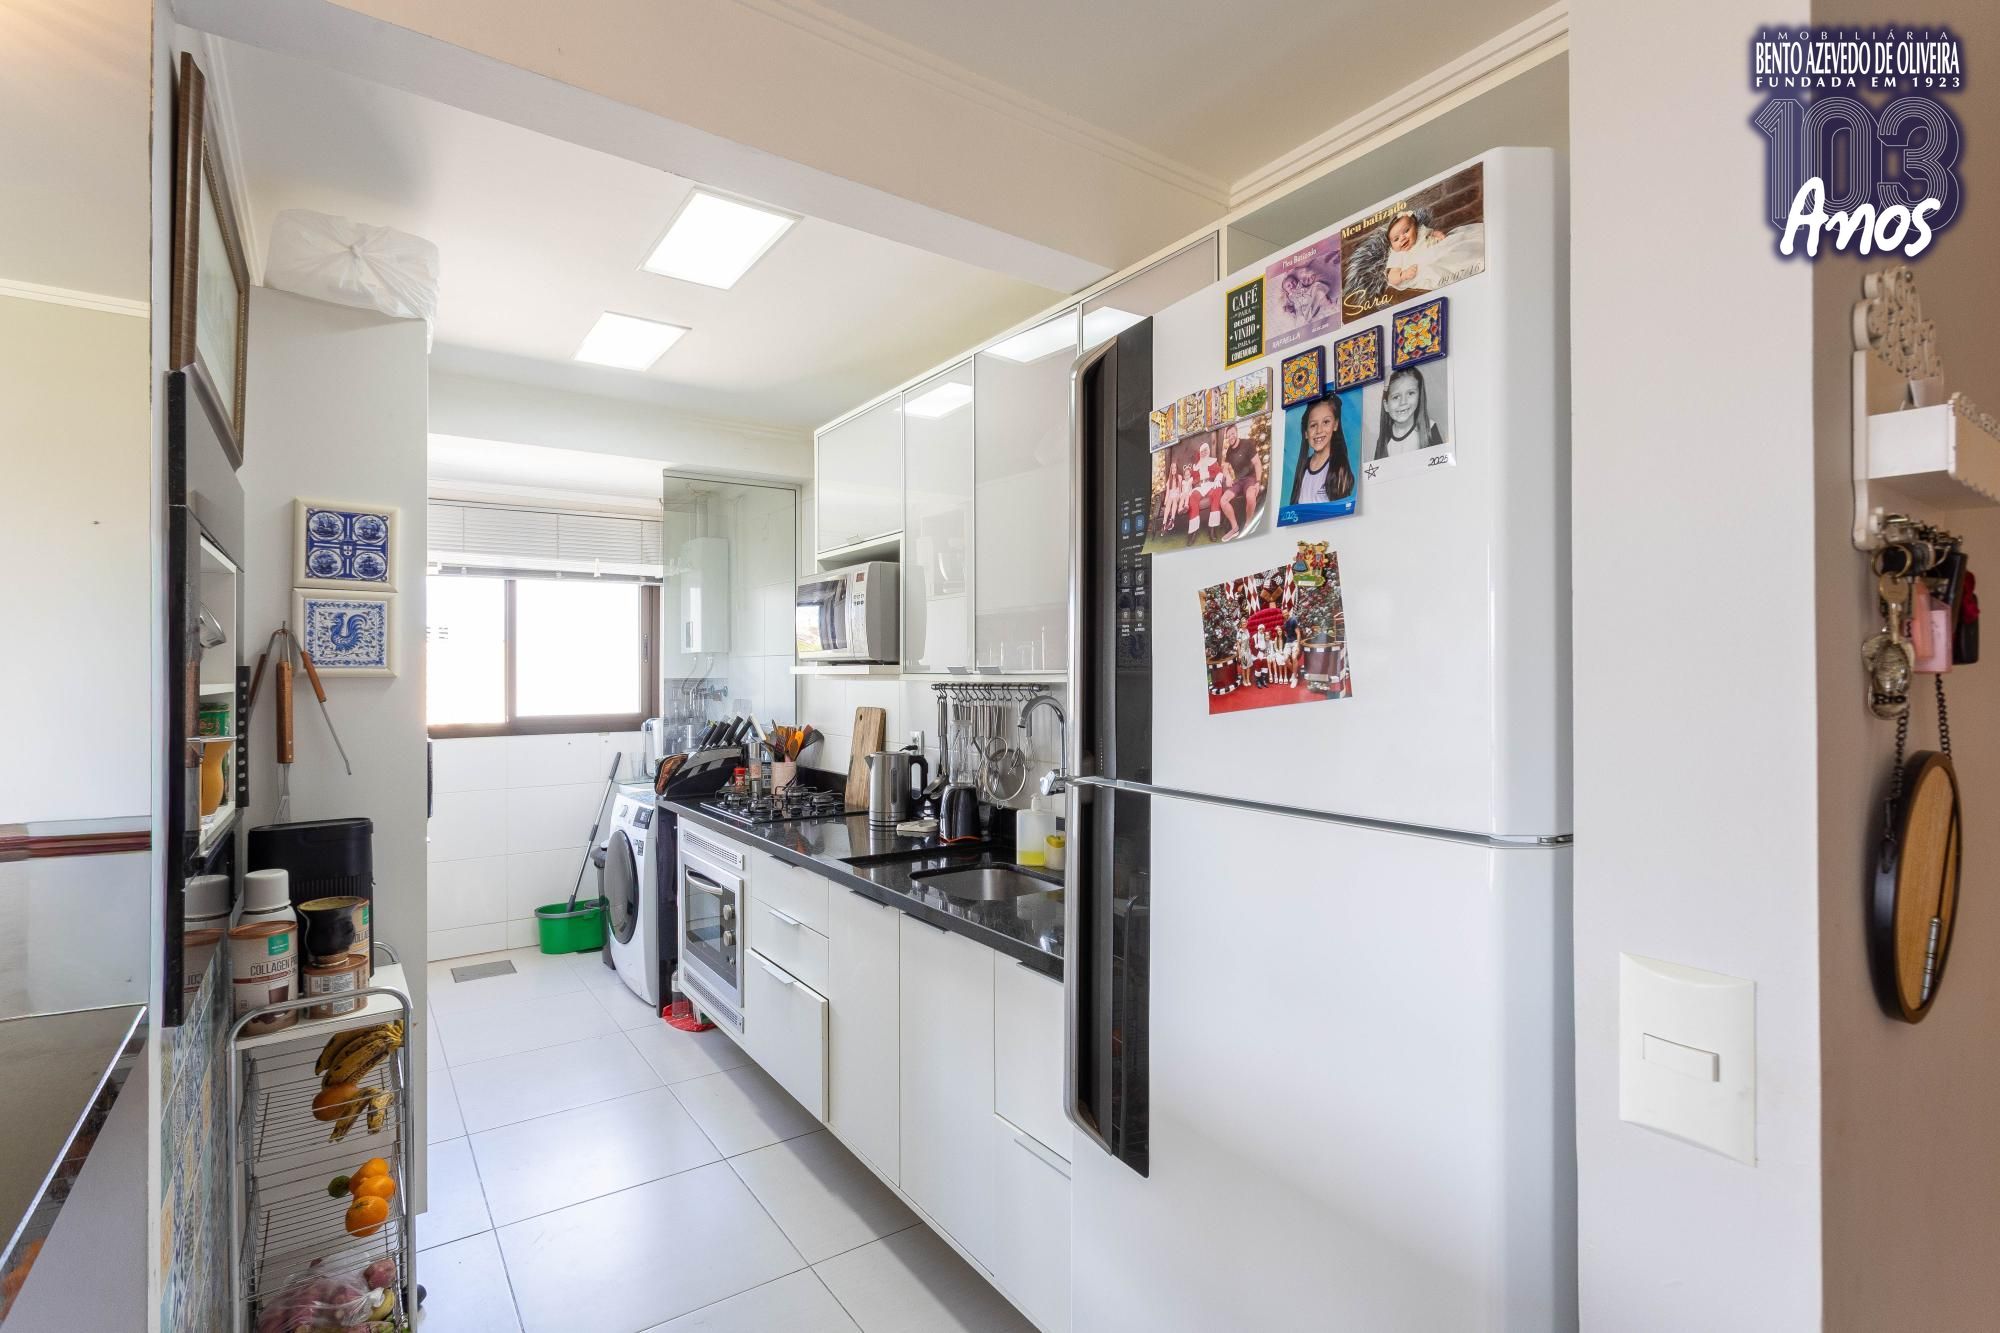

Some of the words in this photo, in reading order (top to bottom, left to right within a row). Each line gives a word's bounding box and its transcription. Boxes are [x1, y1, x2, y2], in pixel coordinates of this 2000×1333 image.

[1232, 284, 1258, 311] CAFÉ
[1344, 289, 1393, 315] Sara
[1234, 324, 1256, 341] VINHO
[250, 958, 290, 977] COLLAGEN
